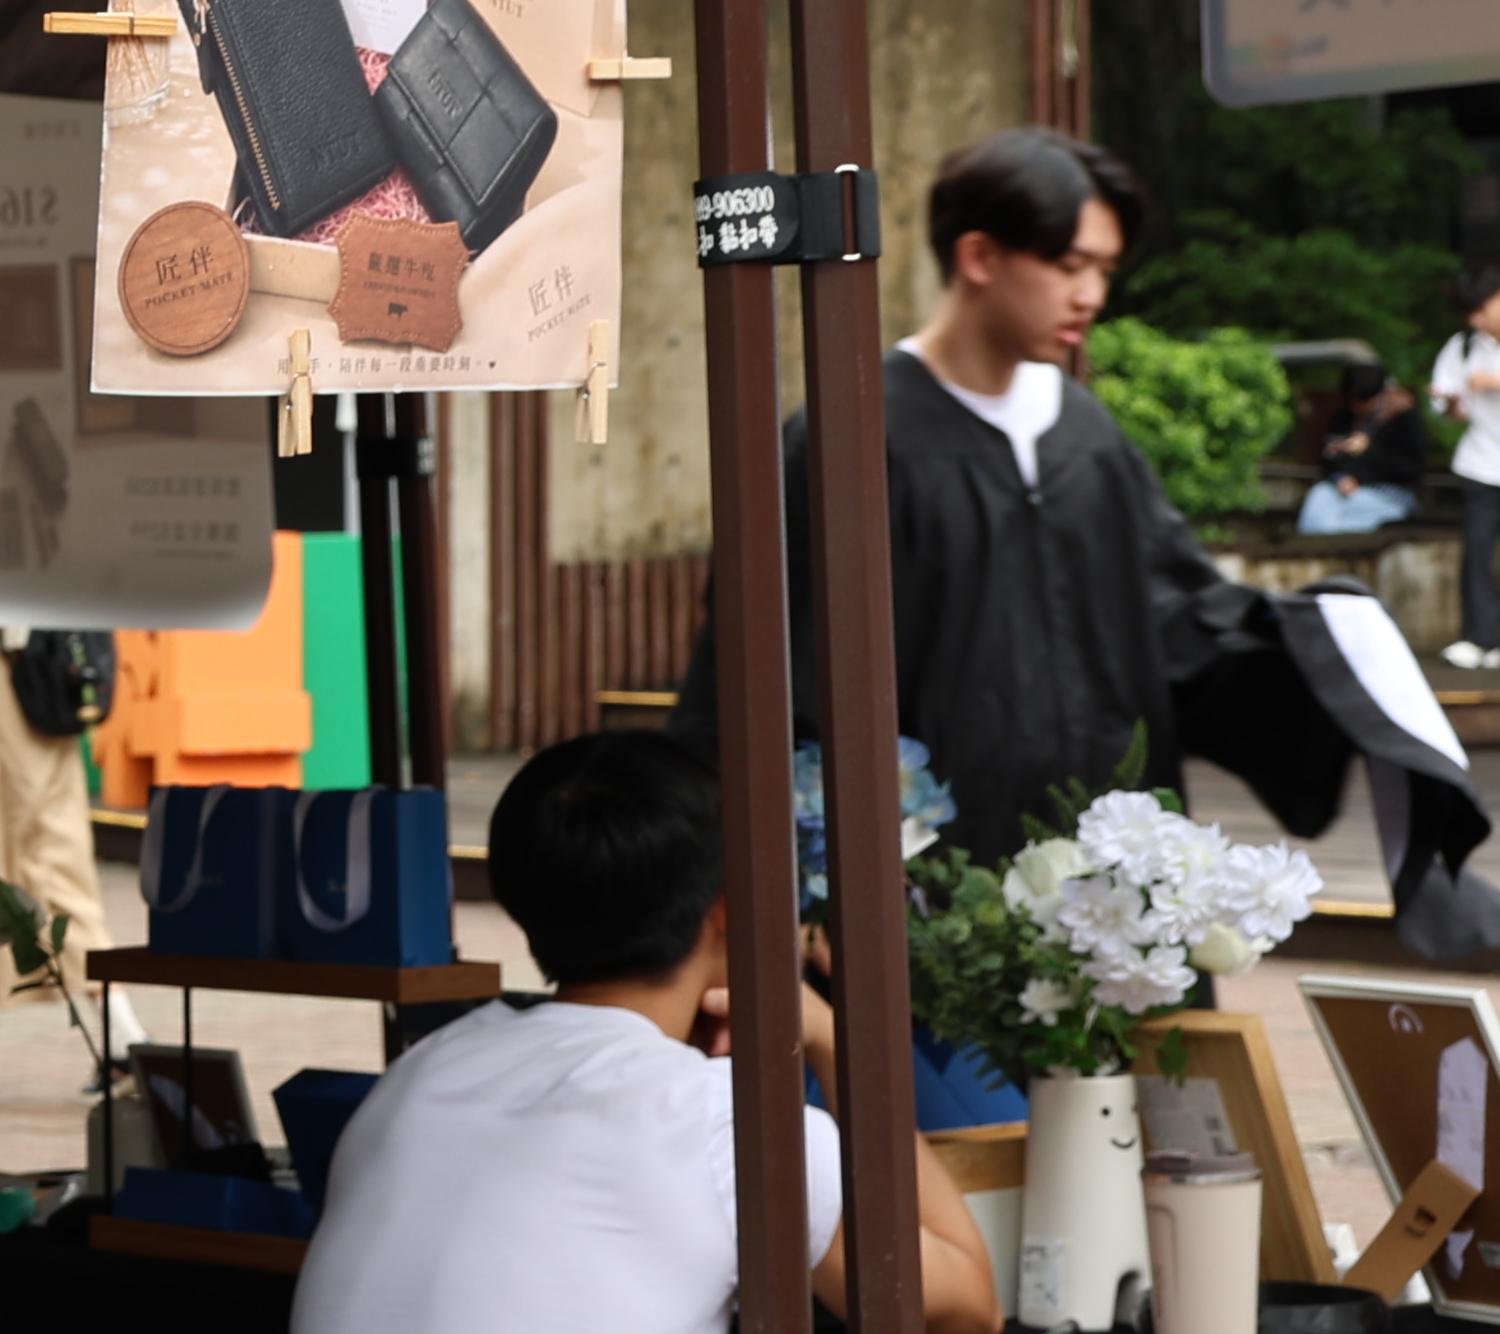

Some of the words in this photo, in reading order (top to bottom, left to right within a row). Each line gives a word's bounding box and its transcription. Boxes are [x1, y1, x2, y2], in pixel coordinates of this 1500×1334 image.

[154, 244, 215, 286] 匠伴
[144, 285, 197, 309] POCKET
[199, 271, 234, 291] MATE
[528, 264, 575, 317] 匠伴
